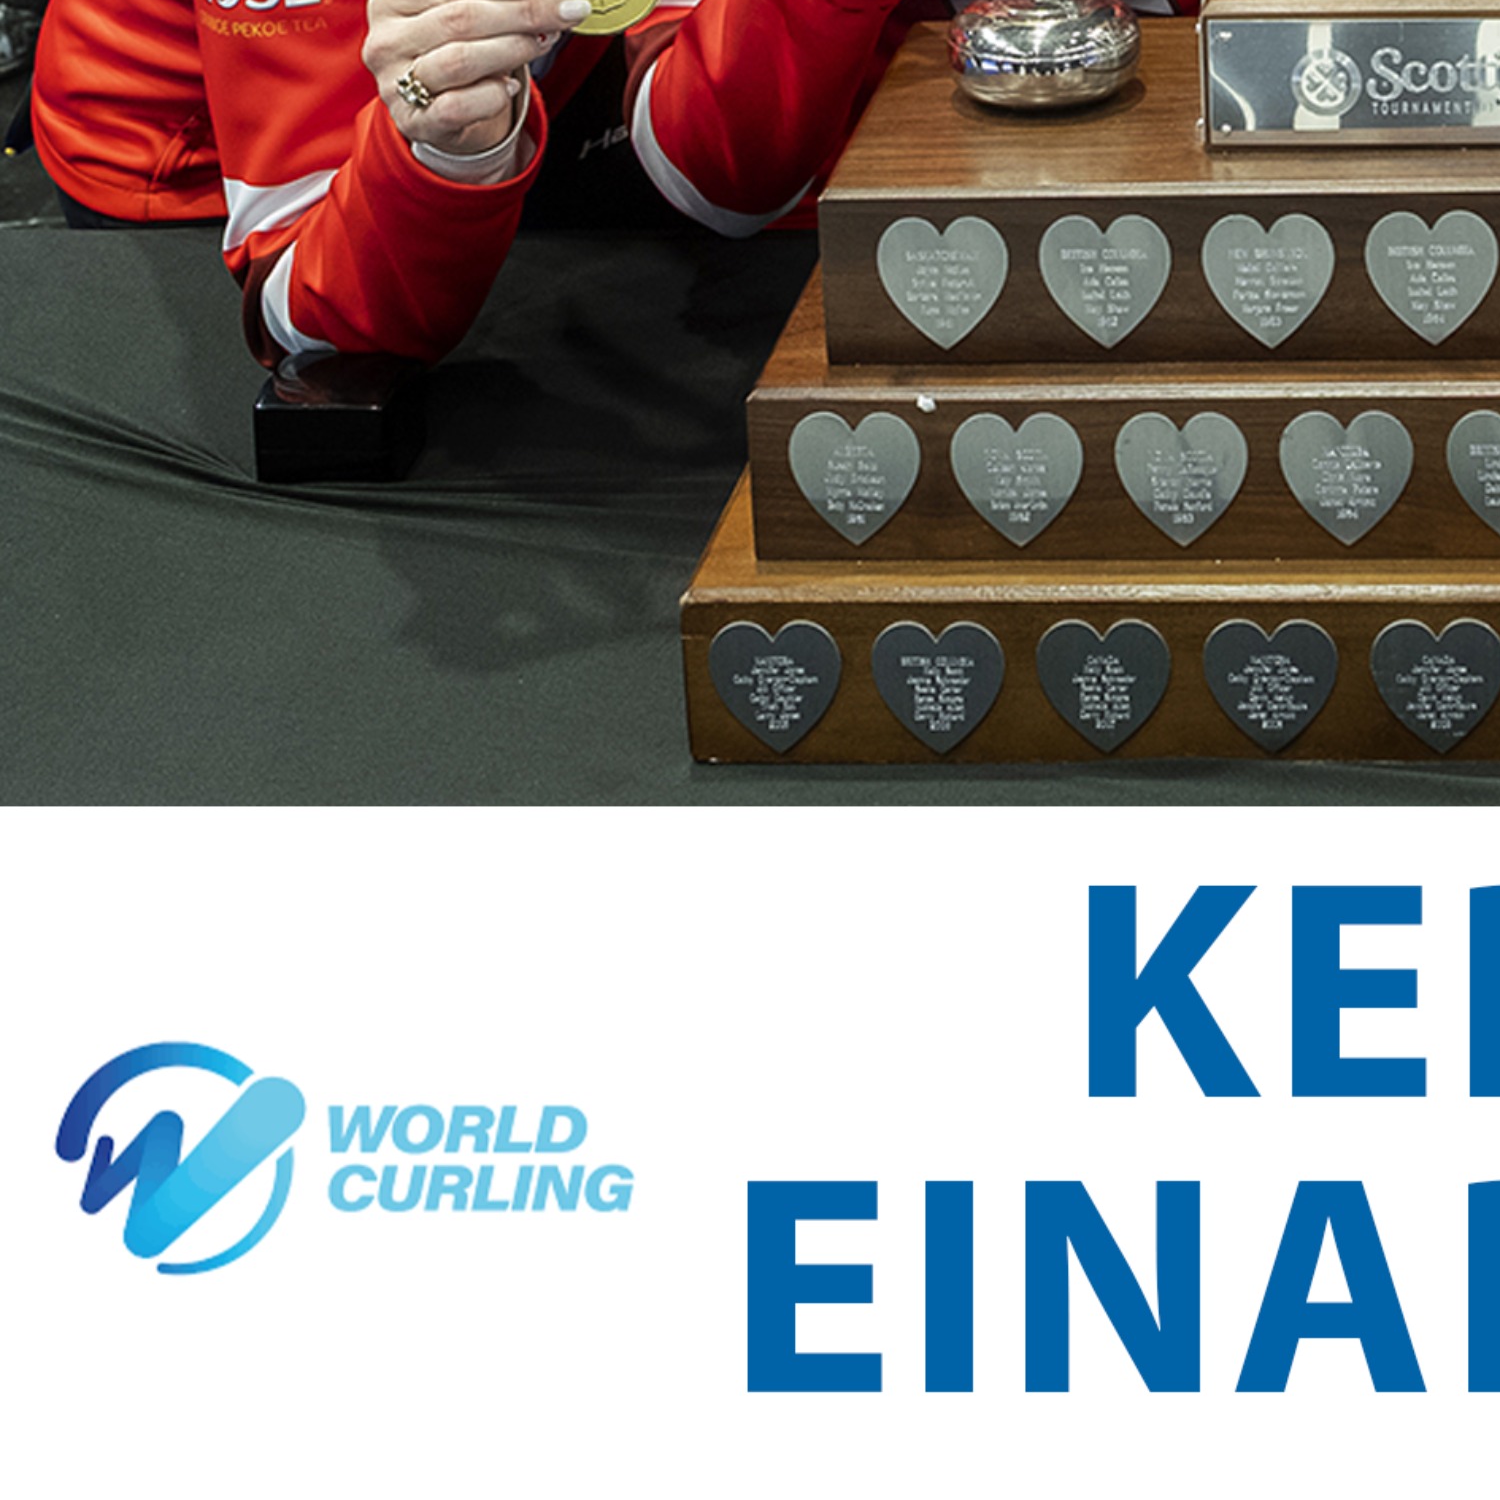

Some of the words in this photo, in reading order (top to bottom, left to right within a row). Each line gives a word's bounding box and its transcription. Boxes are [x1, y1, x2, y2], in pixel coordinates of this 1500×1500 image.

[231, 20, 288, 38] PEKOE
[293, 17, 328, 32] TEA
[1370, 100, 1474, 117] TOURNAMENT
